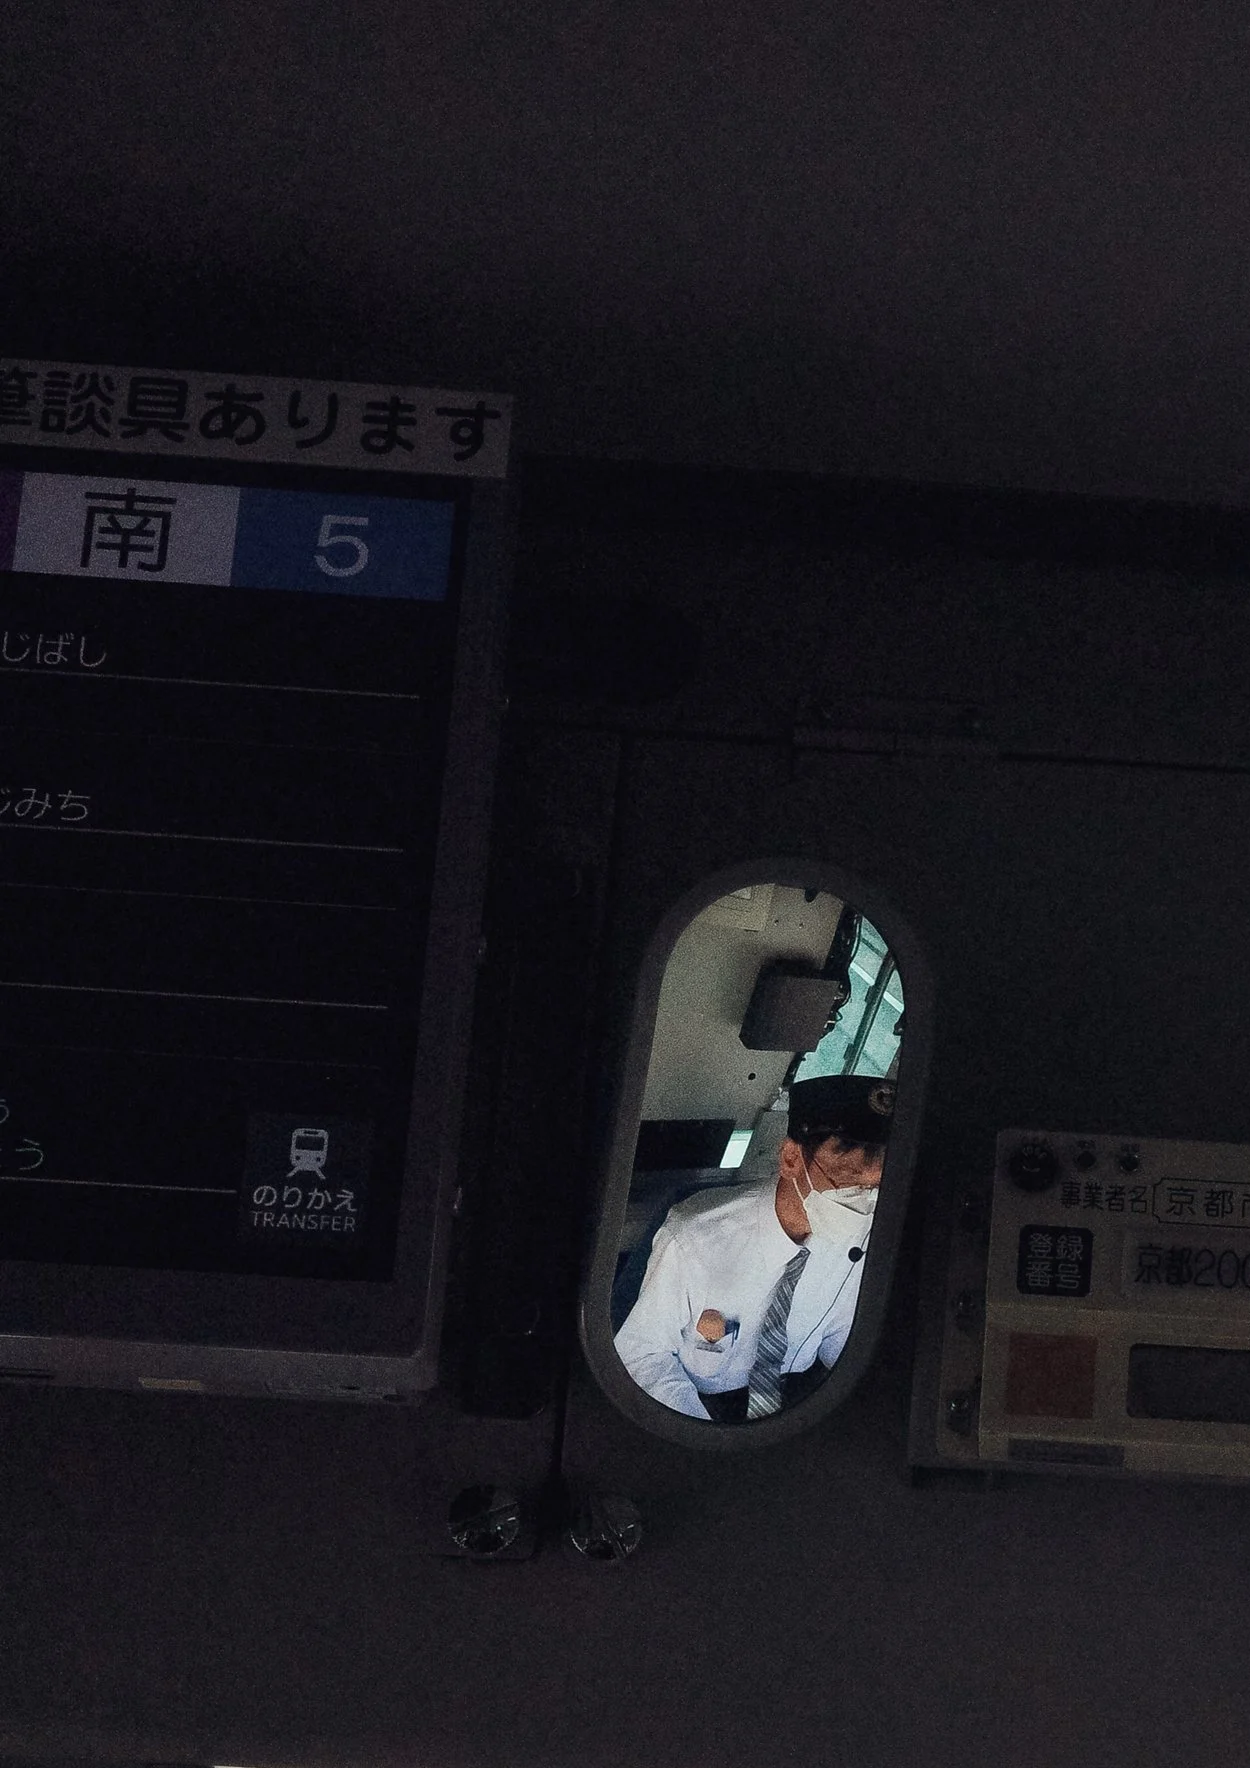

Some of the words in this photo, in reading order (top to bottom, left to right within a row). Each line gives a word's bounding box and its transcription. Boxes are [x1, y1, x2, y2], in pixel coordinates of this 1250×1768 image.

[80, 487, 177, 573] 南
[313, 514, 371, 578] 5
[2, 631, 107, 668] じばし
[252, 1183, 359, 1213] のりかえ
[1061, 1180, 1148, 1215] 事業者名
[250, 1210, 357, 1234] TRANSFER
[1027, 1232, 1084, 1262] 登録
[1025, 1260, 1083, 1290] 番号
